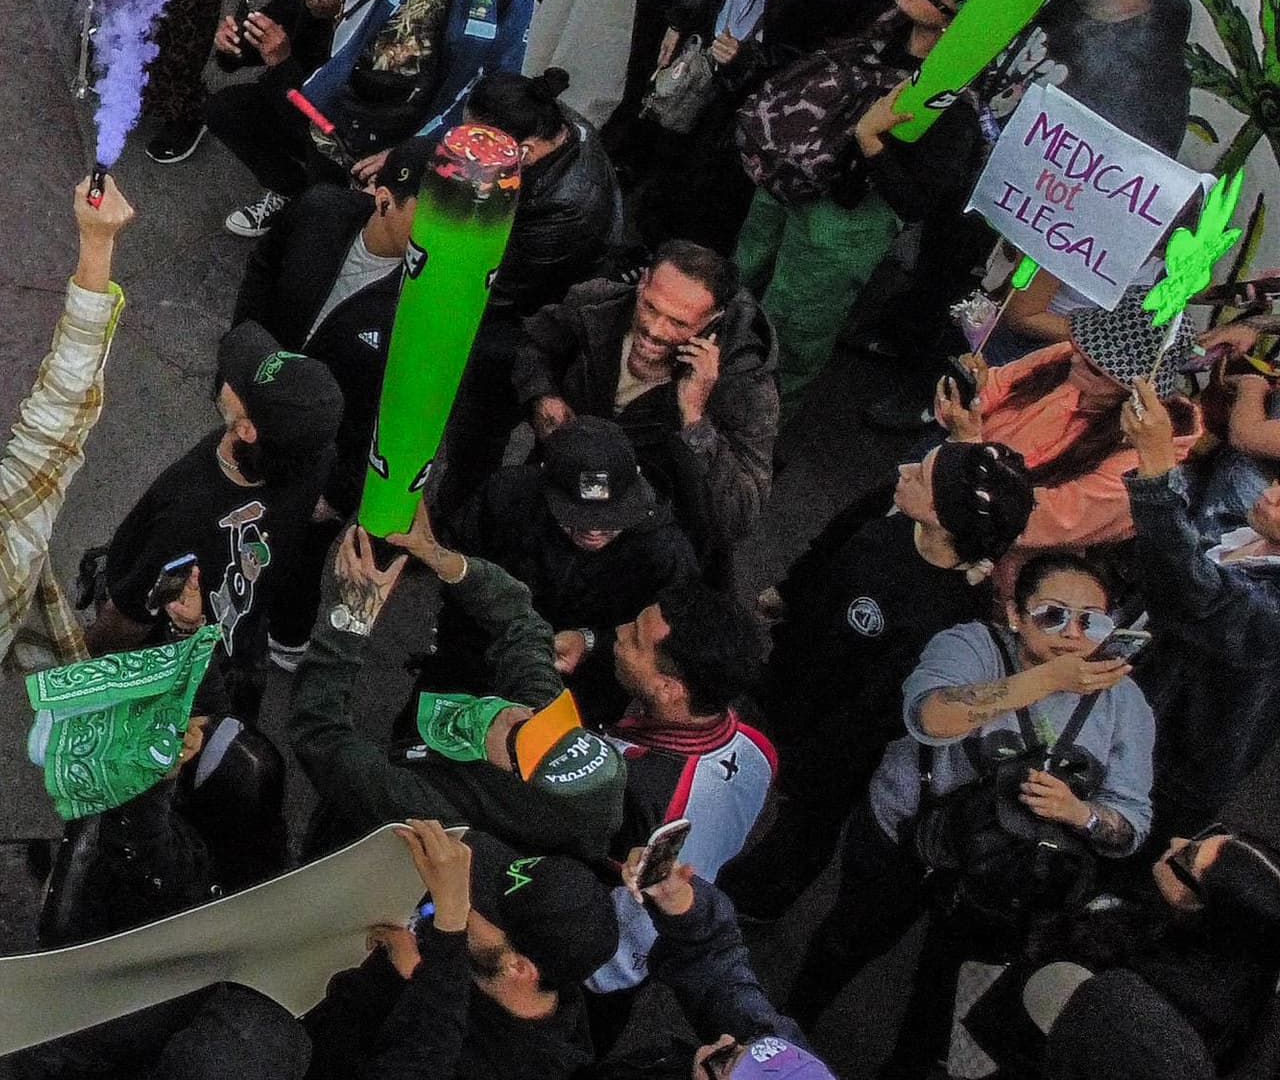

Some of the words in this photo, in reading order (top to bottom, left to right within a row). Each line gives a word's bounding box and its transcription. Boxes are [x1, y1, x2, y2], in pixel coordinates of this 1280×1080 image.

[1024, 111, 1163, 226] MEDICAL
[1034, 167, 1084, 212] not
[994, 181, 1118, 286] ILEGAL
[544, 755, 605, 783] CULTURA
